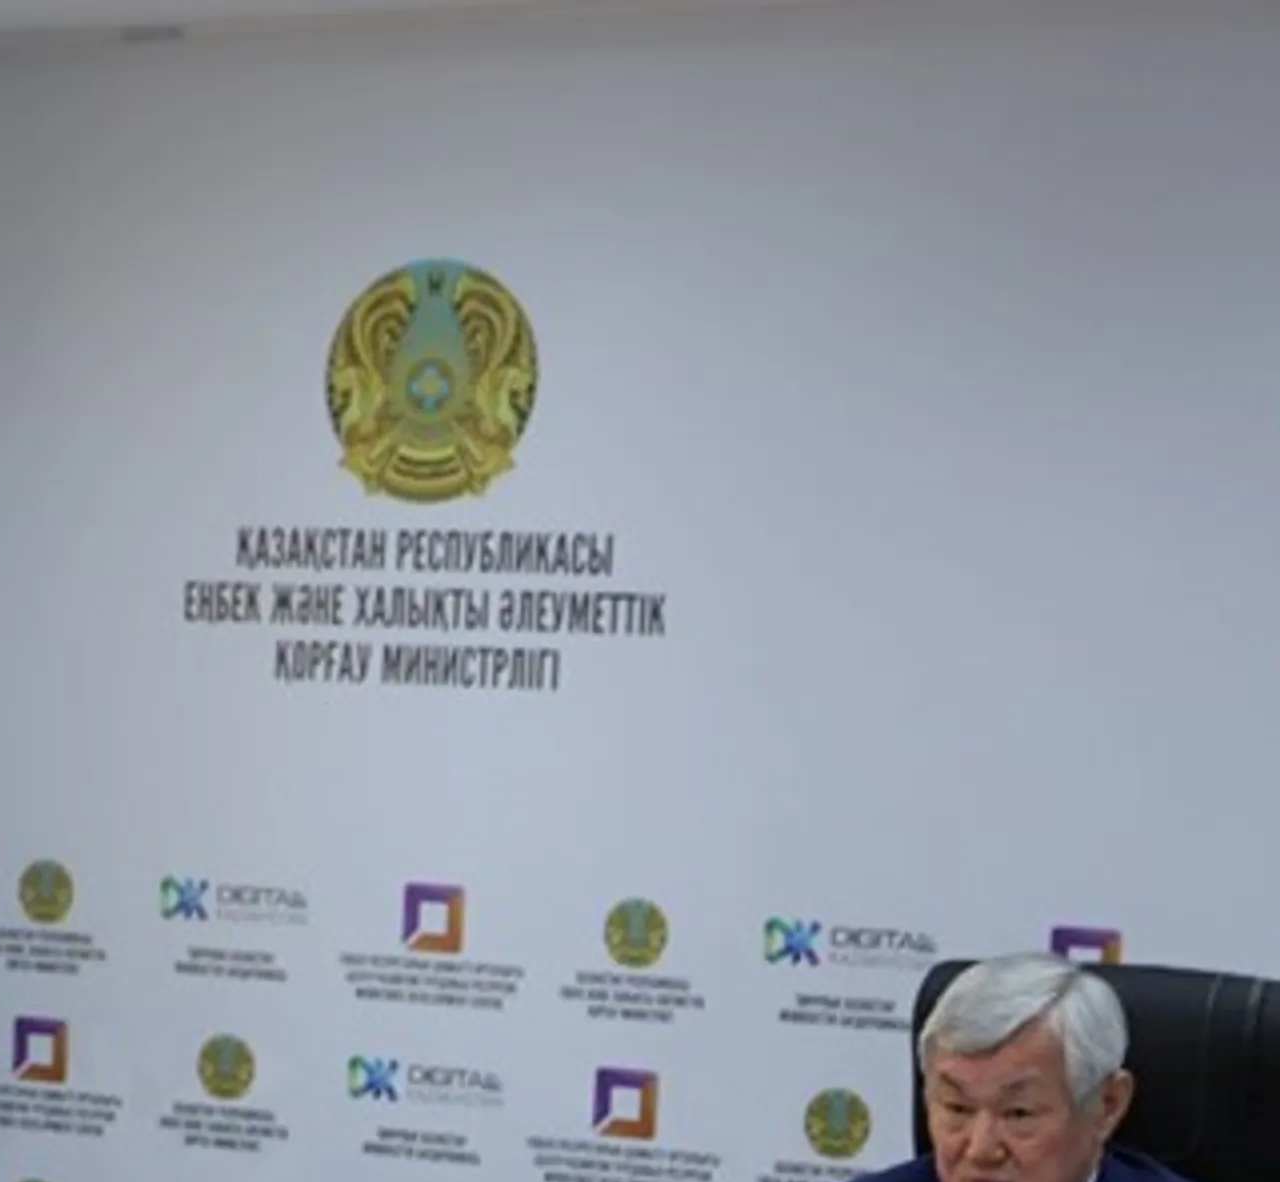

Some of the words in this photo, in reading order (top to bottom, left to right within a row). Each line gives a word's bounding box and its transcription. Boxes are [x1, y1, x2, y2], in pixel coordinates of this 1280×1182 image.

[236, 527, 386, 573] ҚАЗАҚСТАН
[396, 530, 613, 575] РЕСПУБЛИКАСЫ
[183, 582, 262, 626] ЕҢБЕК
[270, 585, 344, 627] ЖӘНЕ
[353, 586, 489, 635] ХАЛЫҚТЫ
[499, 591, 666, 636] ӘЛЕУМЕТТІК
[274, 640, 371, 687] ҚОРҒАУ
[380, 645, 560, 690] МИНИСТРЛІГІ
